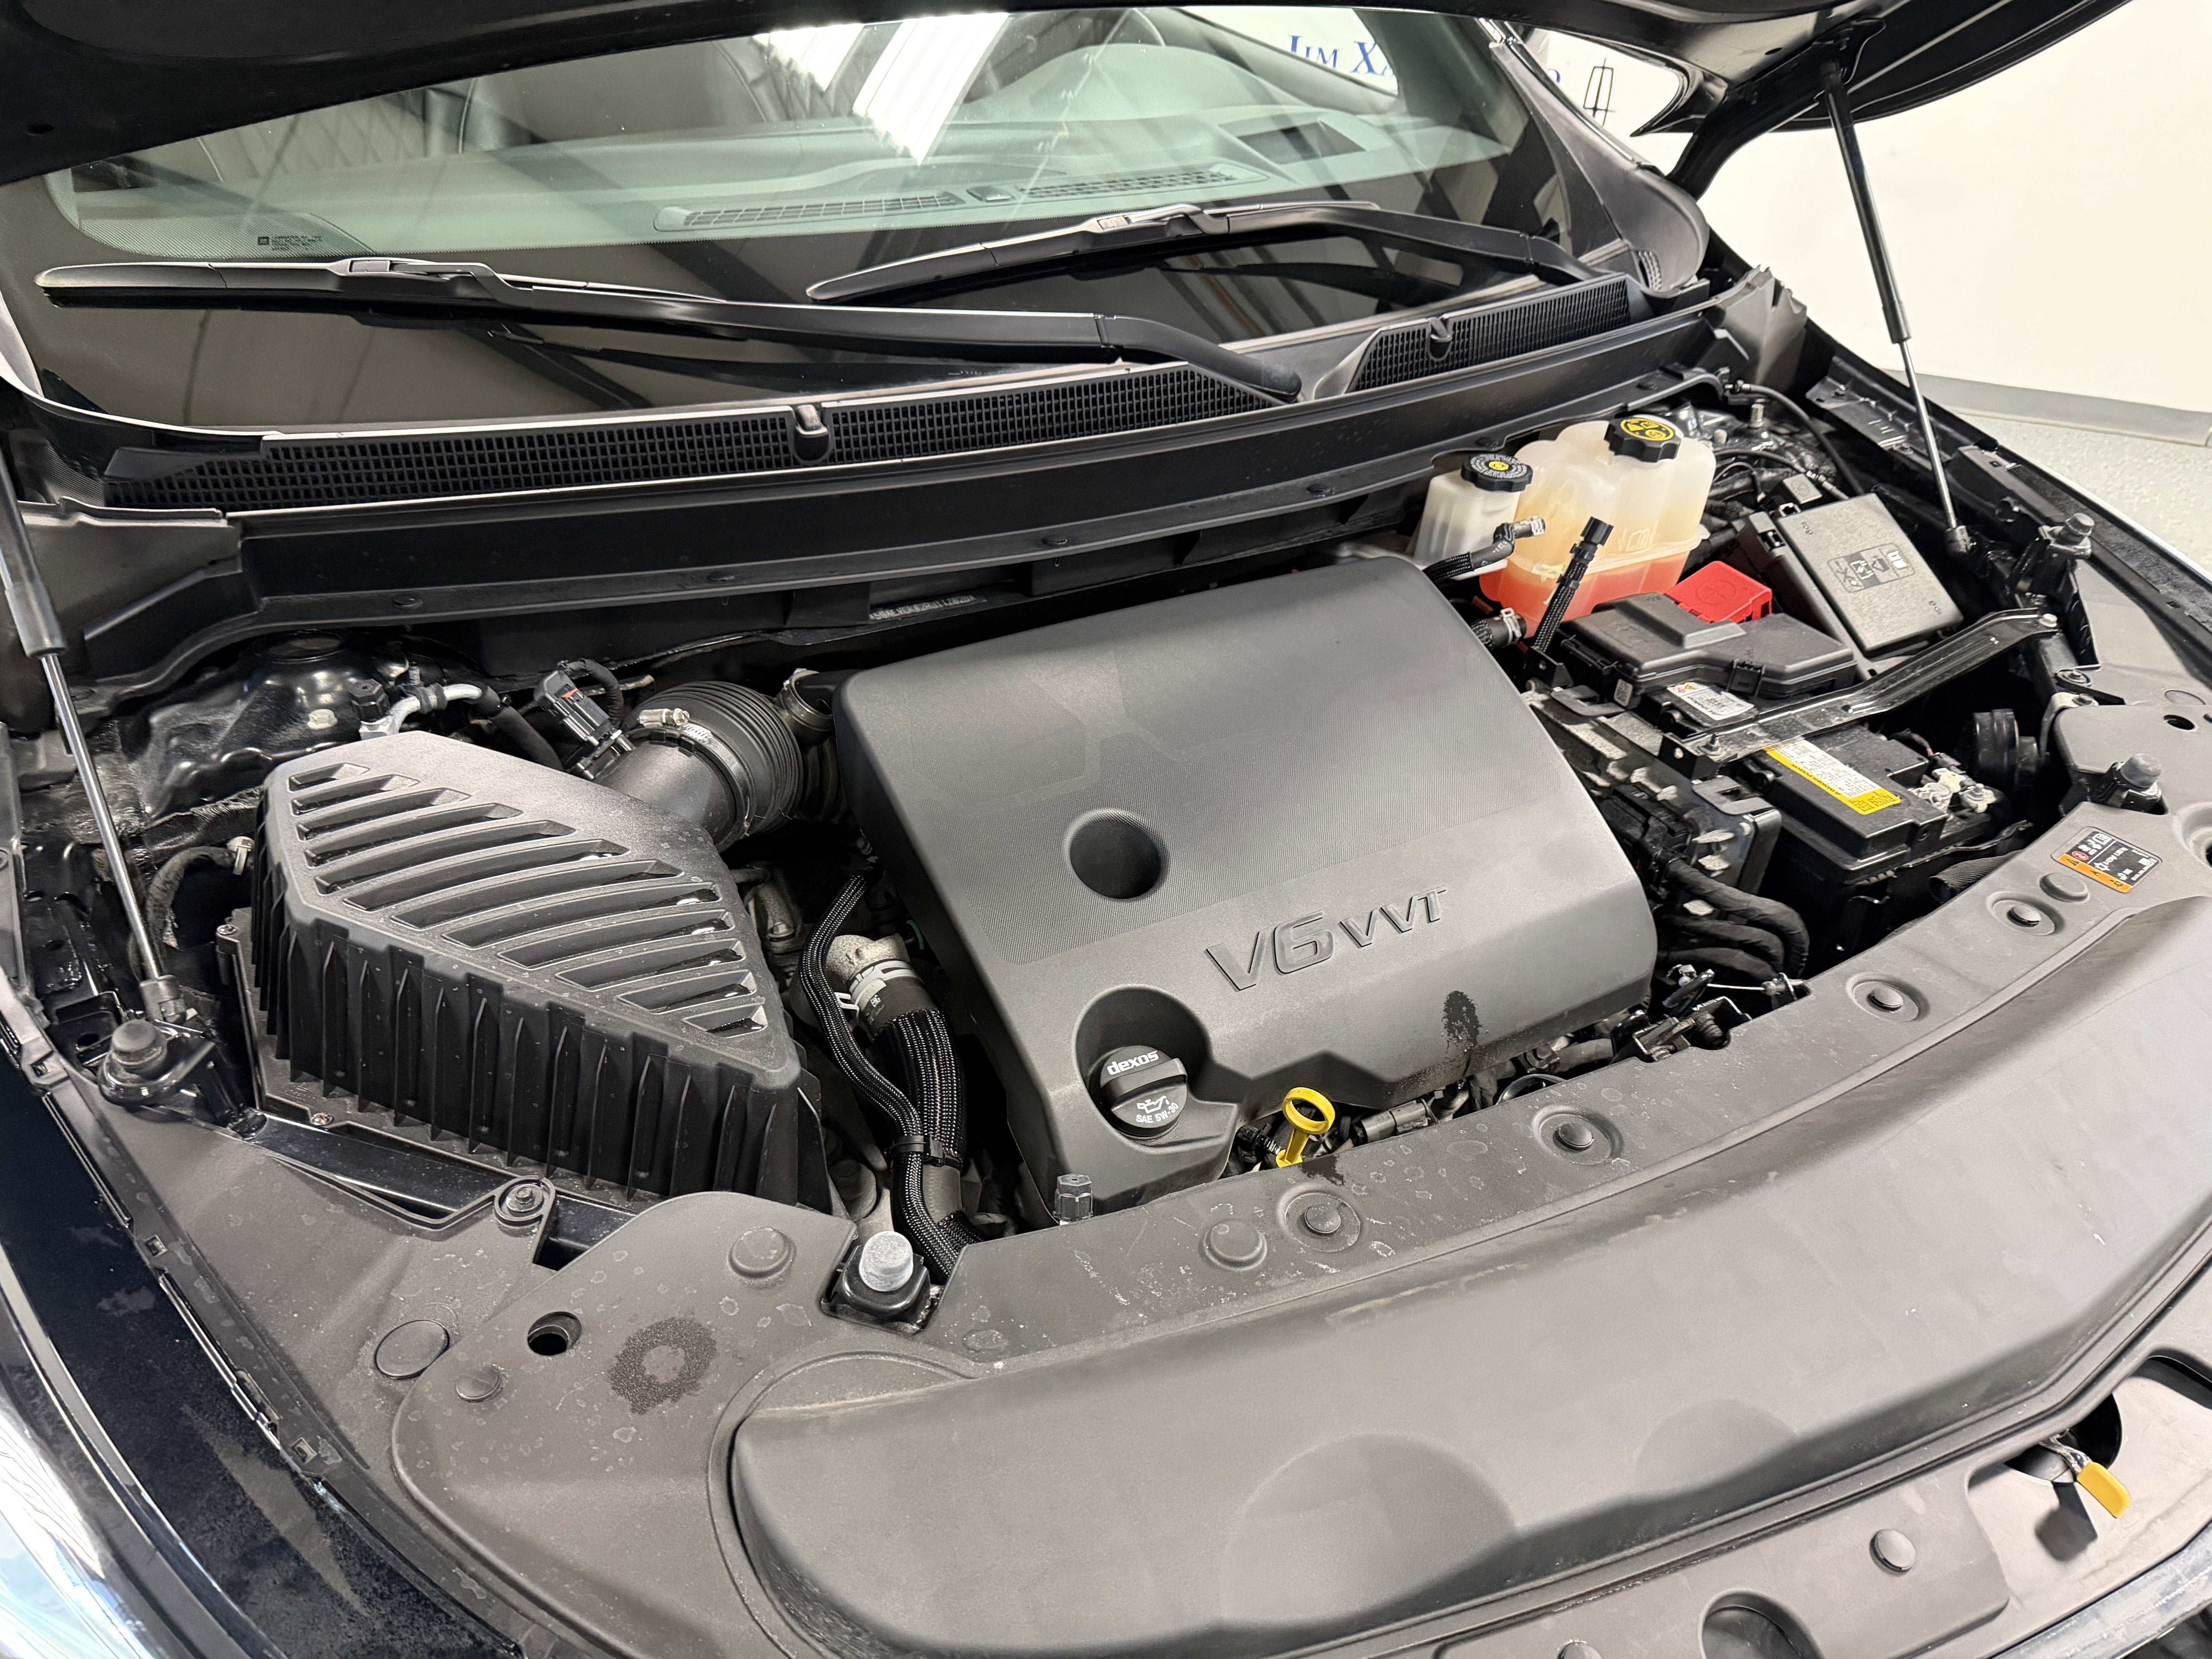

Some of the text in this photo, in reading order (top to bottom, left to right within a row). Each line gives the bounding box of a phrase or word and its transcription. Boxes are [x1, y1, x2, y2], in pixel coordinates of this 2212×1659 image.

[1205, 885, 1447, 991] V6 VVT
[1107, 1050, 1159, 1075] dexos
[1136, 1103, 1179, 1123] SAE 5W-30
